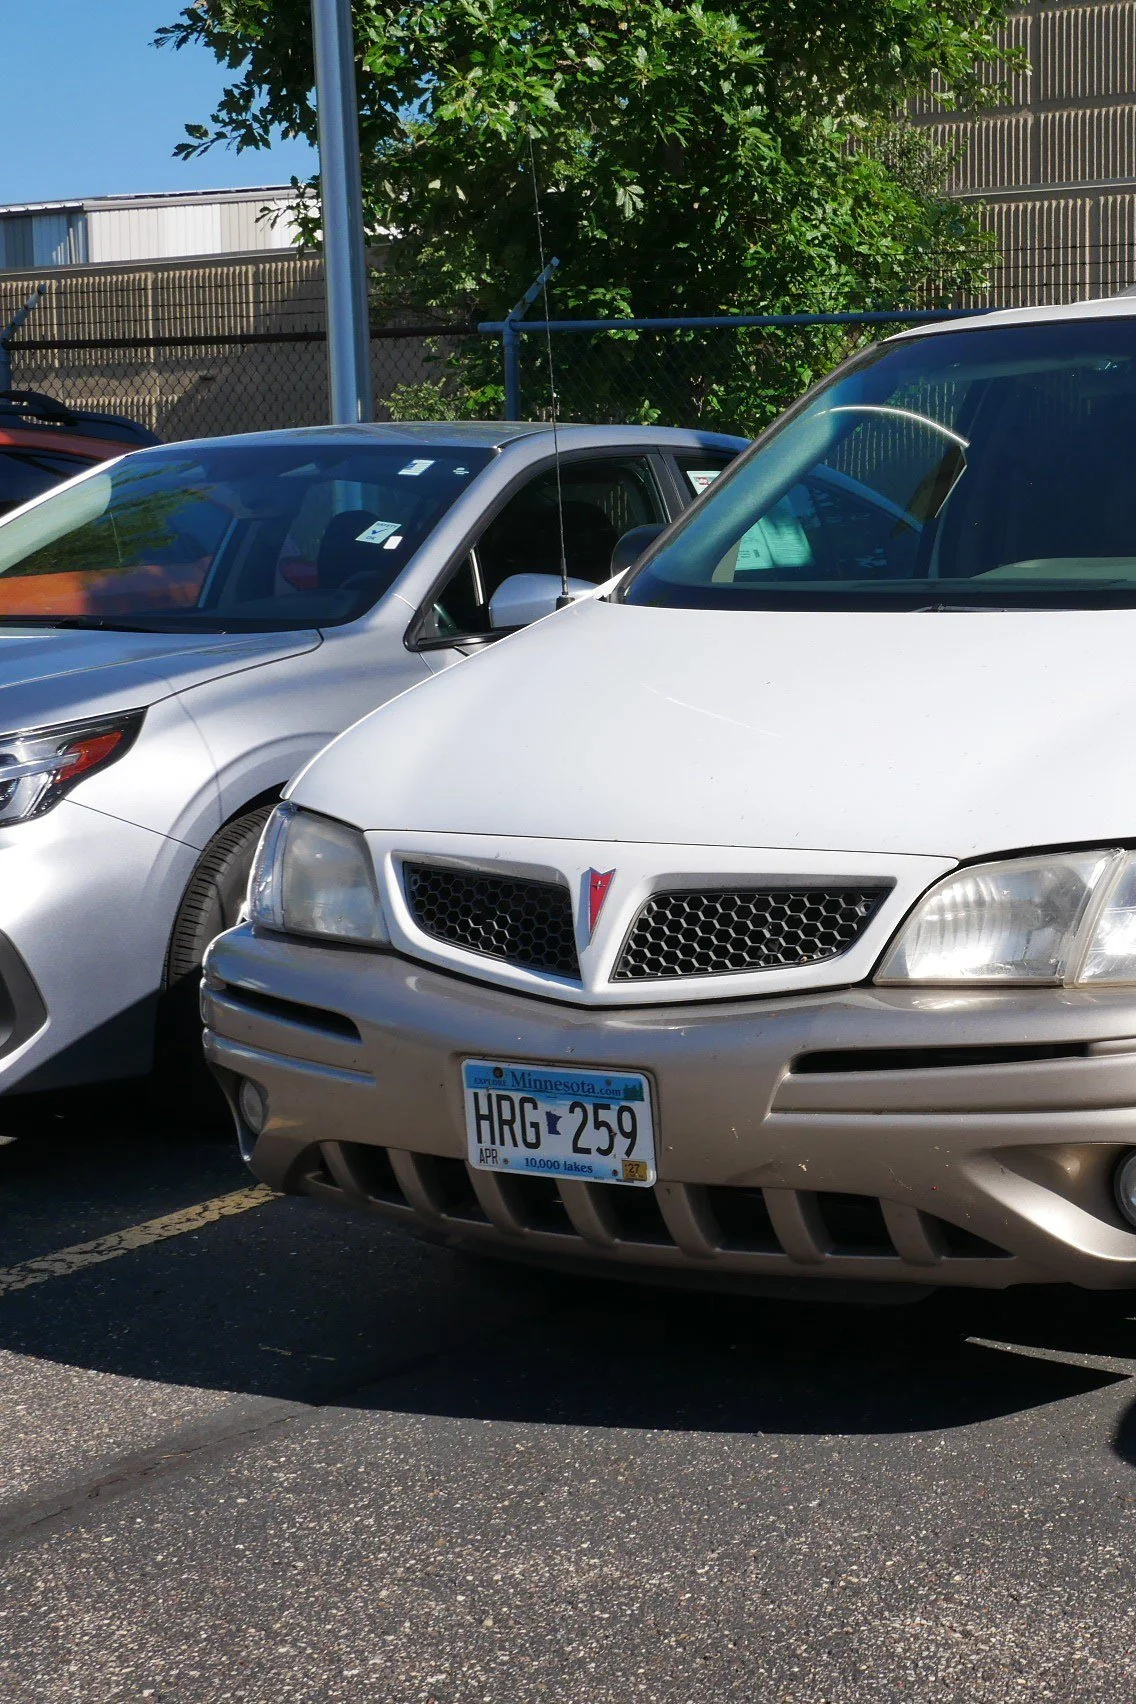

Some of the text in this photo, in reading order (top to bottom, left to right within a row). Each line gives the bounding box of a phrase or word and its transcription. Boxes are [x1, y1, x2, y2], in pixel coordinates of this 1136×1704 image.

[473, 1071, 621, 1097] EXPLORE Minnesota.com
[473, 1091, 638, 1159] HRG 259
[478, 1147, 499, 1166] APR
[524, 1156, 594, 1174] 10,000 lakes
